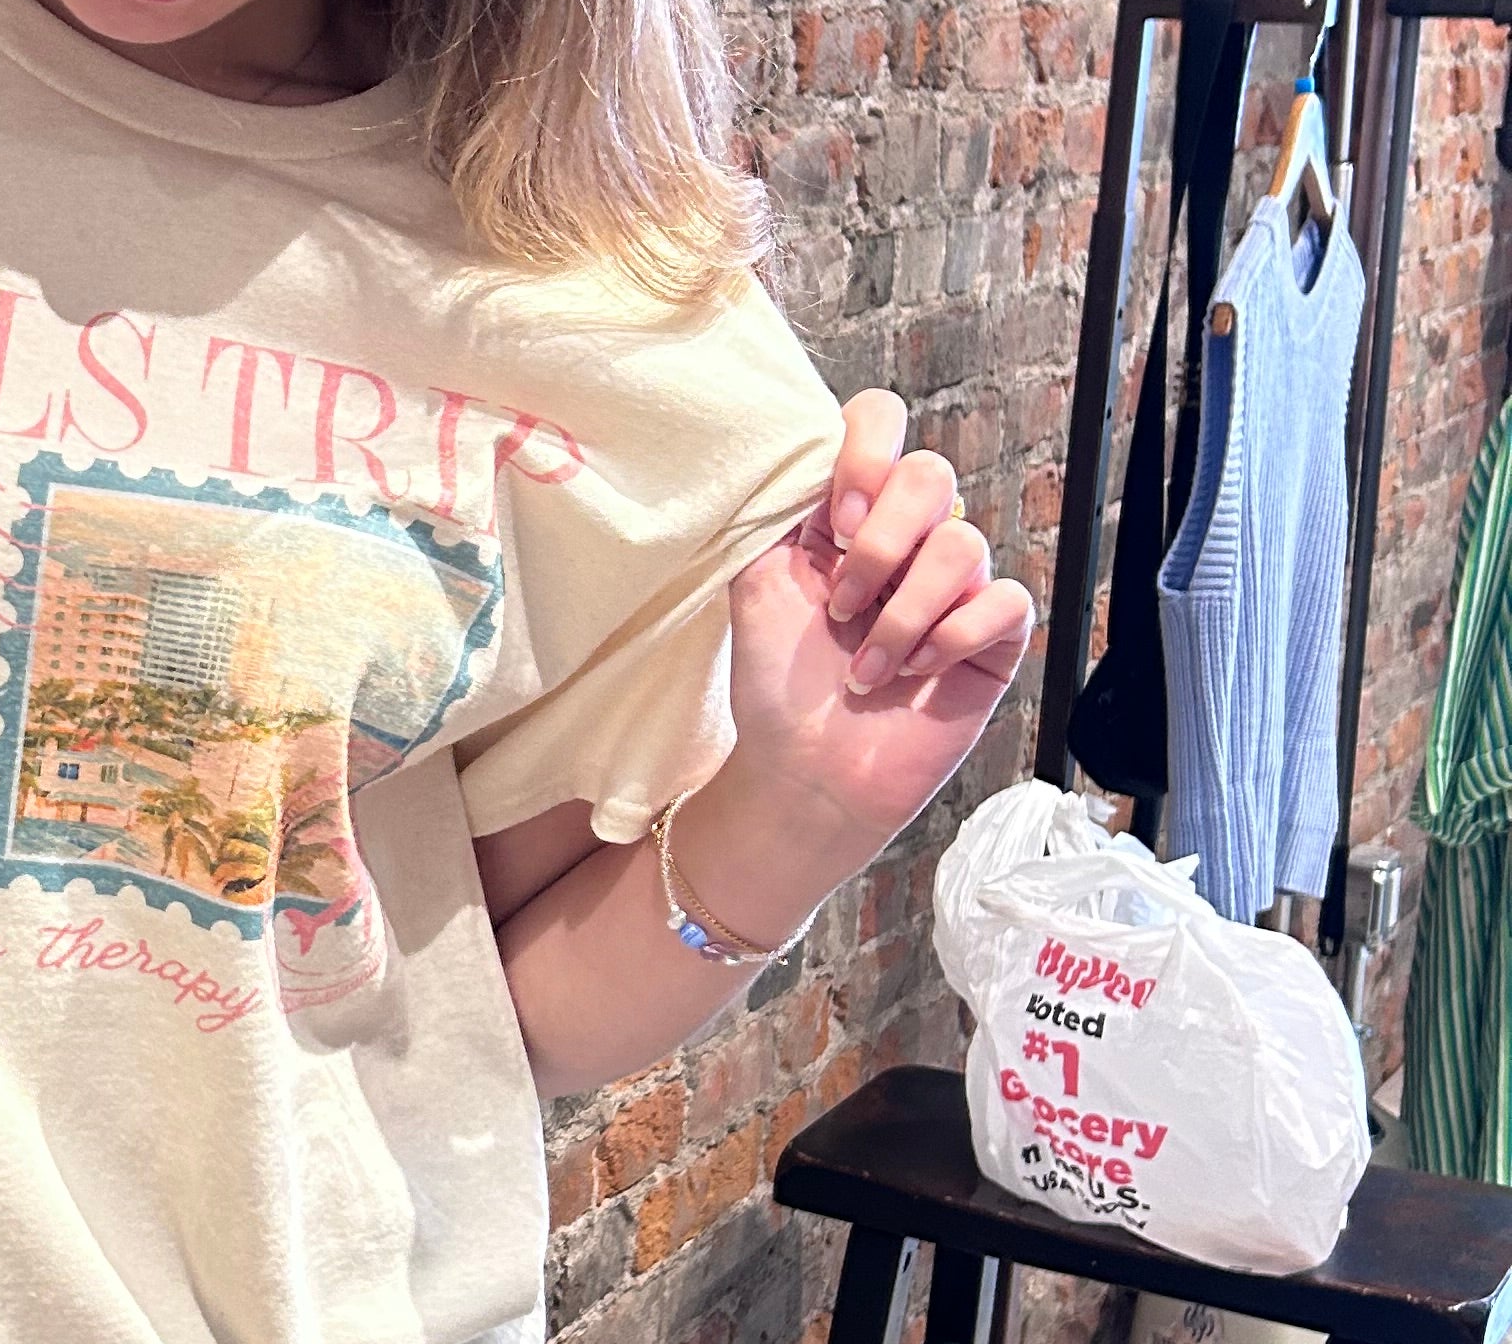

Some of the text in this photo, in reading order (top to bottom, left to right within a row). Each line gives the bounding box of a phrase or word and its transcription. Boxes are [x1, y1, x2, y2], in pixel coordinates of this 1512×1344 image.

[202, 336, 586, 537] TRIP
[35, 918, 264, 1034] therapy
[1000, 1069, 1169, 1159] Gocery
[1023, 1028, 1080, 1097] #1
